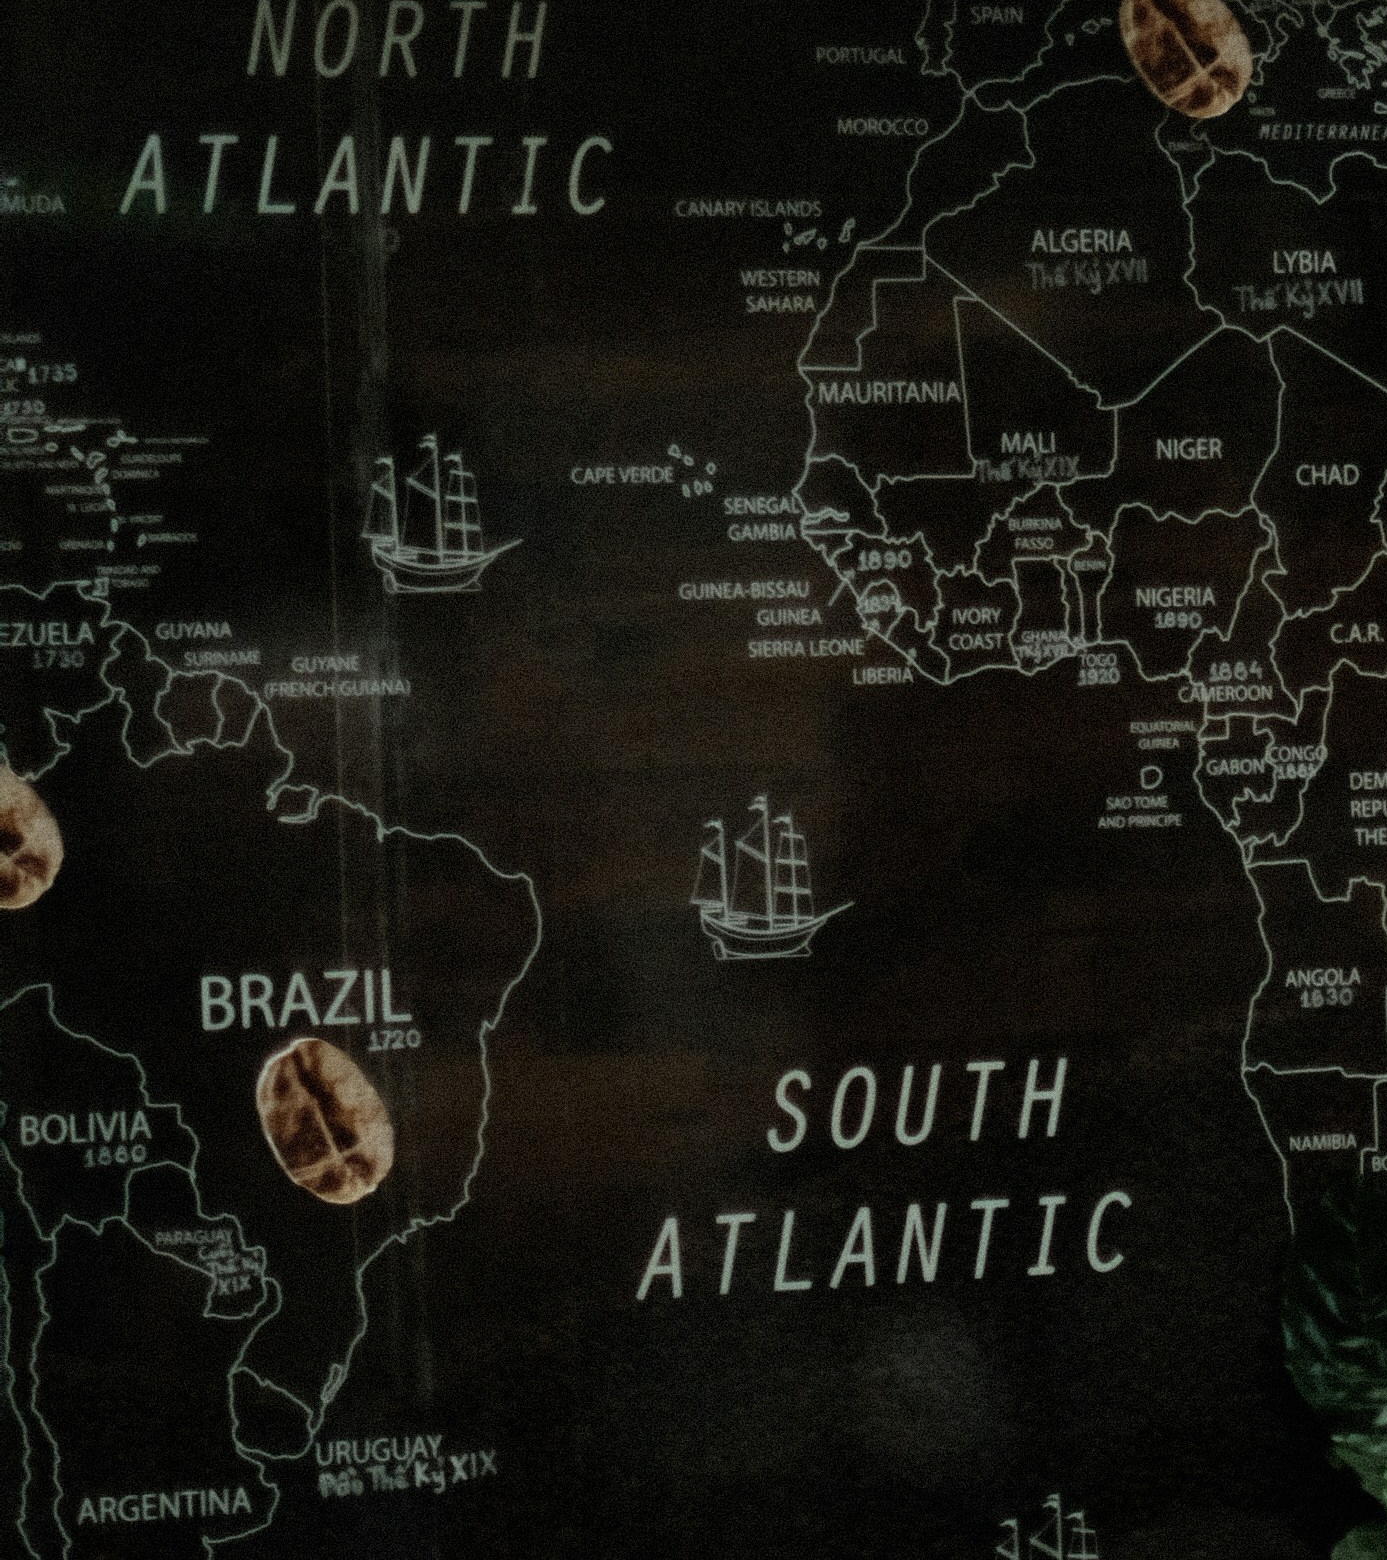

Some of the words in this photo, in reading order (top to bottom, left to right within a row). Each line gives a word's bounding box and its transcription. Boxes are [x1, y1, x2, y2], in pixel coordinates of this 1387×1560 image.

[969, 5, 1024, 26] SPAIN
[815, 47, 907, 67] PORTUGAL
[836, 117, 930, 138] MOROCCO
[118, 133, 614, 216] ATLANTIC
[674, 199, 748, 218] CANARY
[749, 198, 823, 217] ISLANDS
[1030, 228, 1133, 253] ALGERIA
[1272, 249, 1337, 276] LYBIA
[740, 269, 822, 288] WESTERN
[745, 295, 817, 314] SAHARA
[28, 362, 79, 386] 1735
[817, 381, 963, 405] MAURITANIA
[1000, 433, 1056, 455] MALI
[1155, 438, 1223, 459] NIGER
[571, 464, 613, 486] CAPE
[616, 462, 677, 485] VERDE
[1295, 463, 1360, 487] CHAD
[724, 496, 800, 516] SENEGAL
[728, 523, 798, 542] GAMBIA
[1008, 516, 1064, 533] BURKINA
[857, 549, 914, 573] 1890
[678, 580, 811, 601] GUINEA-BISSAU
[1135, 587, 1216, 608] NIGERIA
[756, 608, 822, 627] GUINEA
[951, 607, 1002, 627] IVORY
[1154, 610, 1203, 630] 1890
[155, 621, 233, 641] GUYANA
[1329, 624, 1384, 644] C.A.R.
[747, 638, 807, 658] SIERRA
[809, 637, 865, 657] LEONE
[948, 633, 1004, 653] COAST
[31, 649, 85, 669] 1730
[182, 649, 262, 668] SURINAME
[291, 655, 360, 673] GUYANE
[852, 666, 914, 686] LIBERIA
[1208, 661, 1264, 681] 1884
[263, 678, 335, 701] (FRENCH
[1178, 685, 1274, 704] CAMEROON
[1138, 737, 1181, 752] GUINEA
[1268, 745, 1328, 762] CONGO
[1206, 756, 1268, 776] GABON
[1285, 968, 1360, 987] ANGOLA
[200, 967, 414, 1032] BRAZIL
[368, 1029, 422, 1052] 1720
[765, 1056, 1069, 1154] SOUTH
[19, 1109, 153, 1146] BOLIVIA
[1289, 1133, 1357, 1151] NAMIBIA
[635, 1189, 1133, 1302] ATLANTIC
[315, 1433, 443, 1467] URUGUAY
[76, 1486, 253, 1527] ARGENTINA
